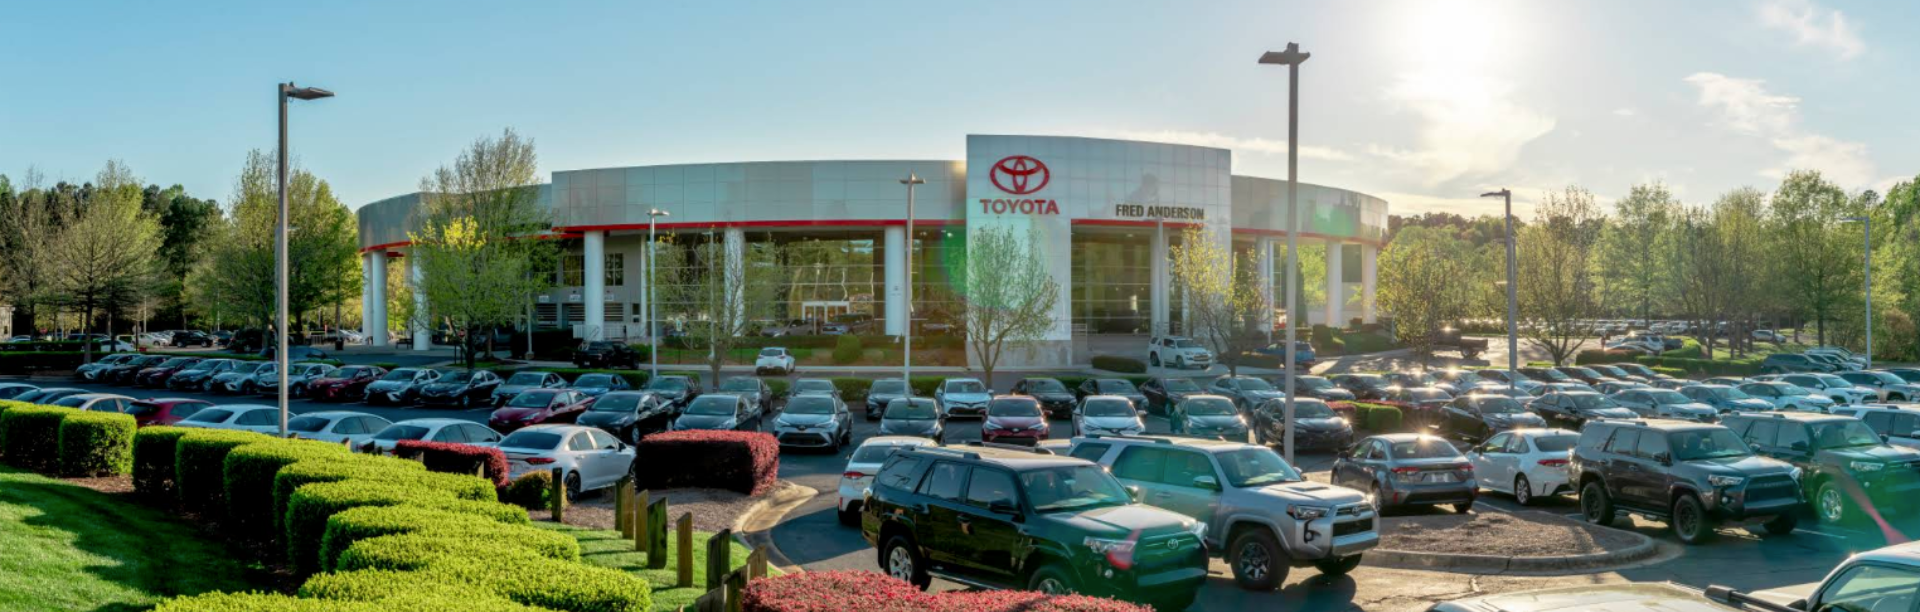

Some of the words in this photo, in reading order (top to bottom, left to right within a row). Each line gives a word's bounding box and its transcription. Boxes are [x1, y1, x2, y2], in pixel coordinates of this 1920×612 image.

[979, 198, 1060, 215] TOYOTA
[1115, 204, 1144, 217] FRED
[1147, 205, 1205, 220] ANDERSON
